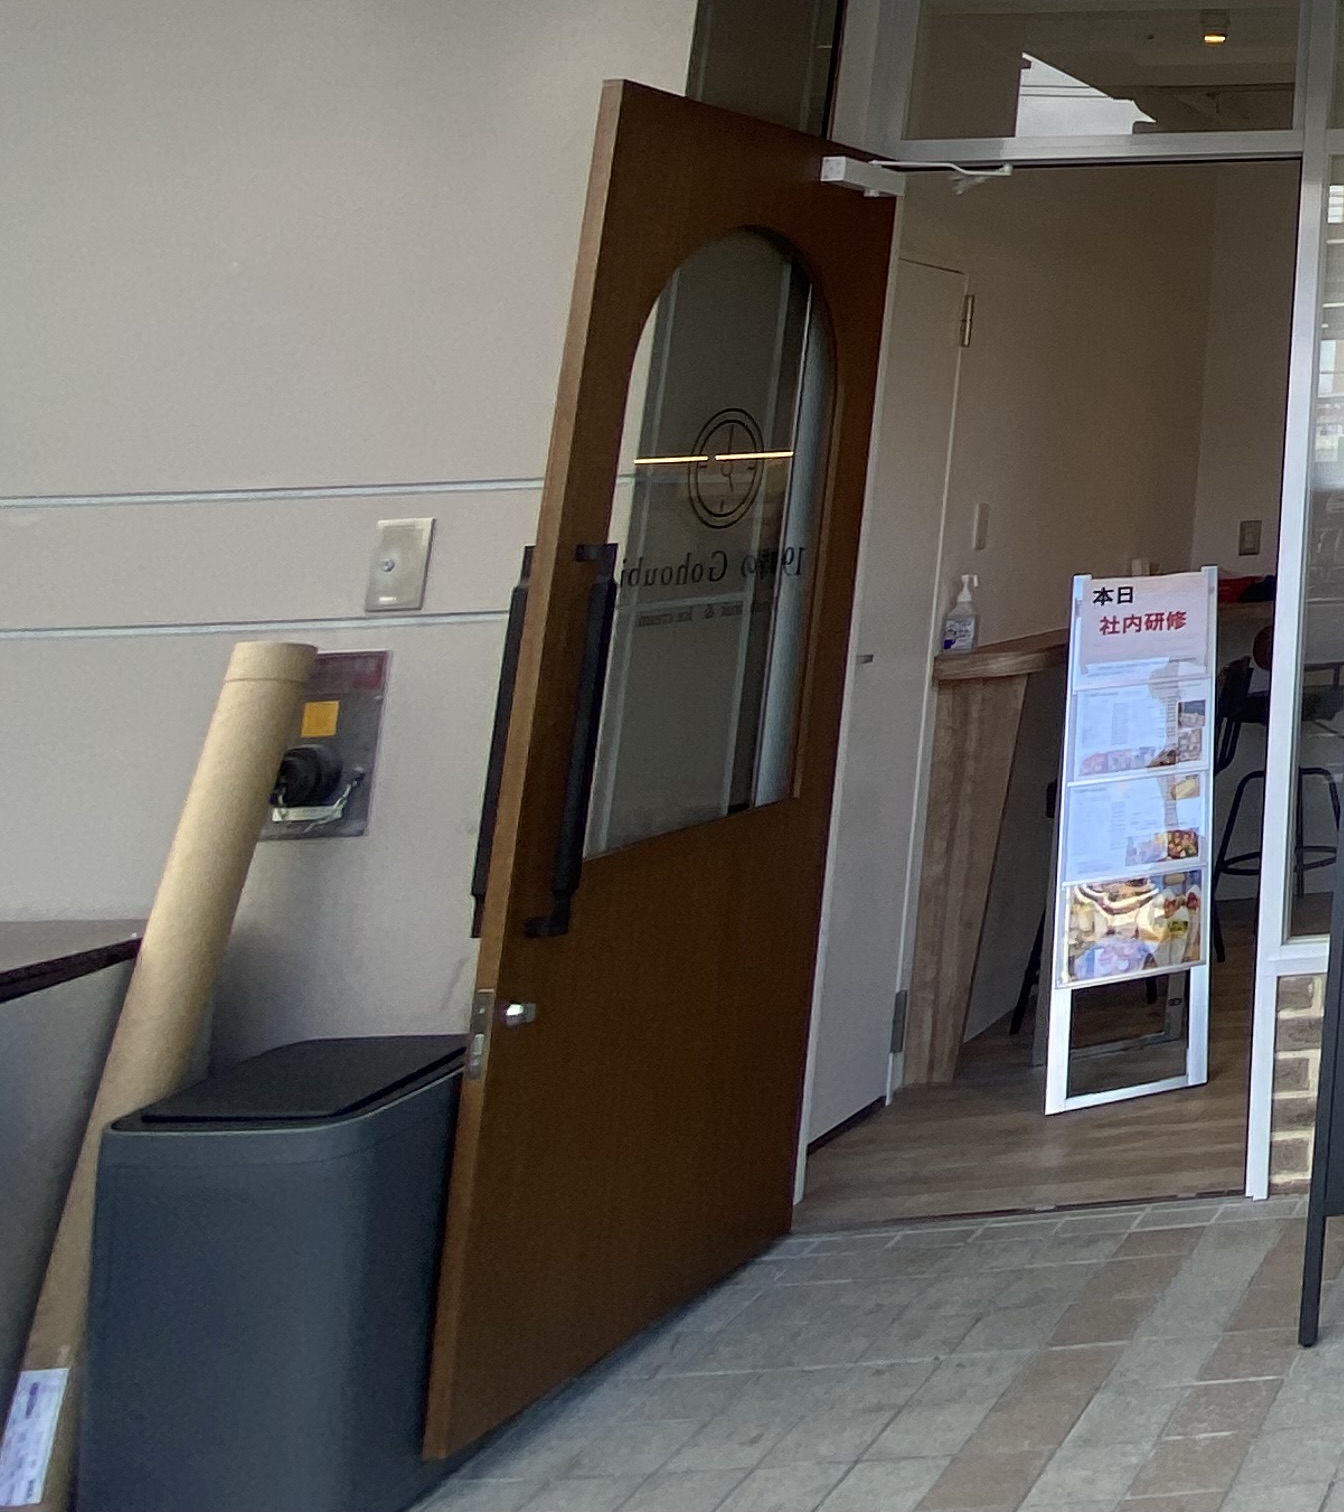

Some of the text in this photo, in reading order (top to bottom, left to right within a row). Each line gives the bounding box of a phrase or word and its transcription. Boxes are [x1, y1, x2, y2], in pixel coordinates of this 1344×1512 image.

[1092, 586, 1134, 607] 本日
[1099, 610, 1188, 637] 社内研修
